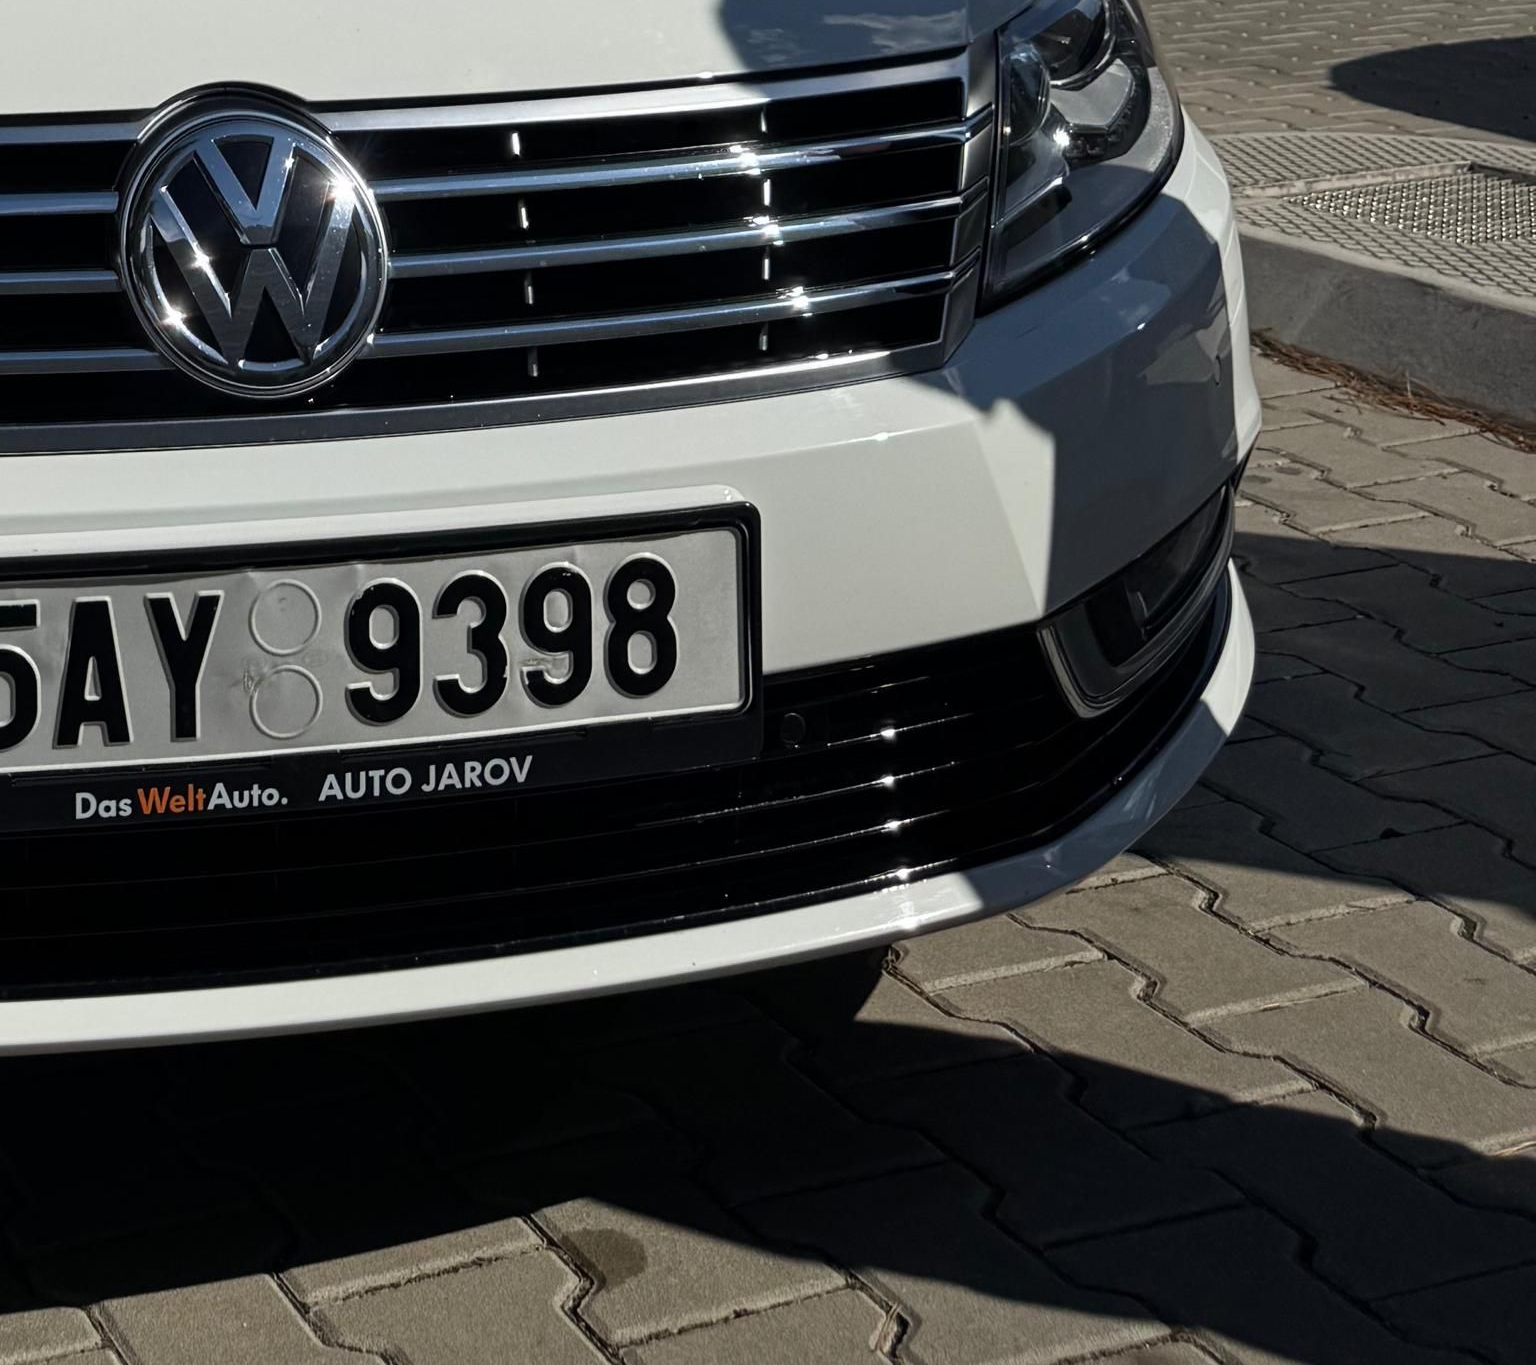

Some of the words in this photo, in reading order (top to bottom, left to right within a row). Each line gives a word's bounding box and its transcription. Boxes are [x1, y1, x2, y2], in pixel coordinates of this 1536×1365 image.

[344, 552, 679, 726] 9398
[318, 767, 413, 802] AUTO
[420, 754, 533, 793] JAROV
[75, 791, 133, 820] Das
